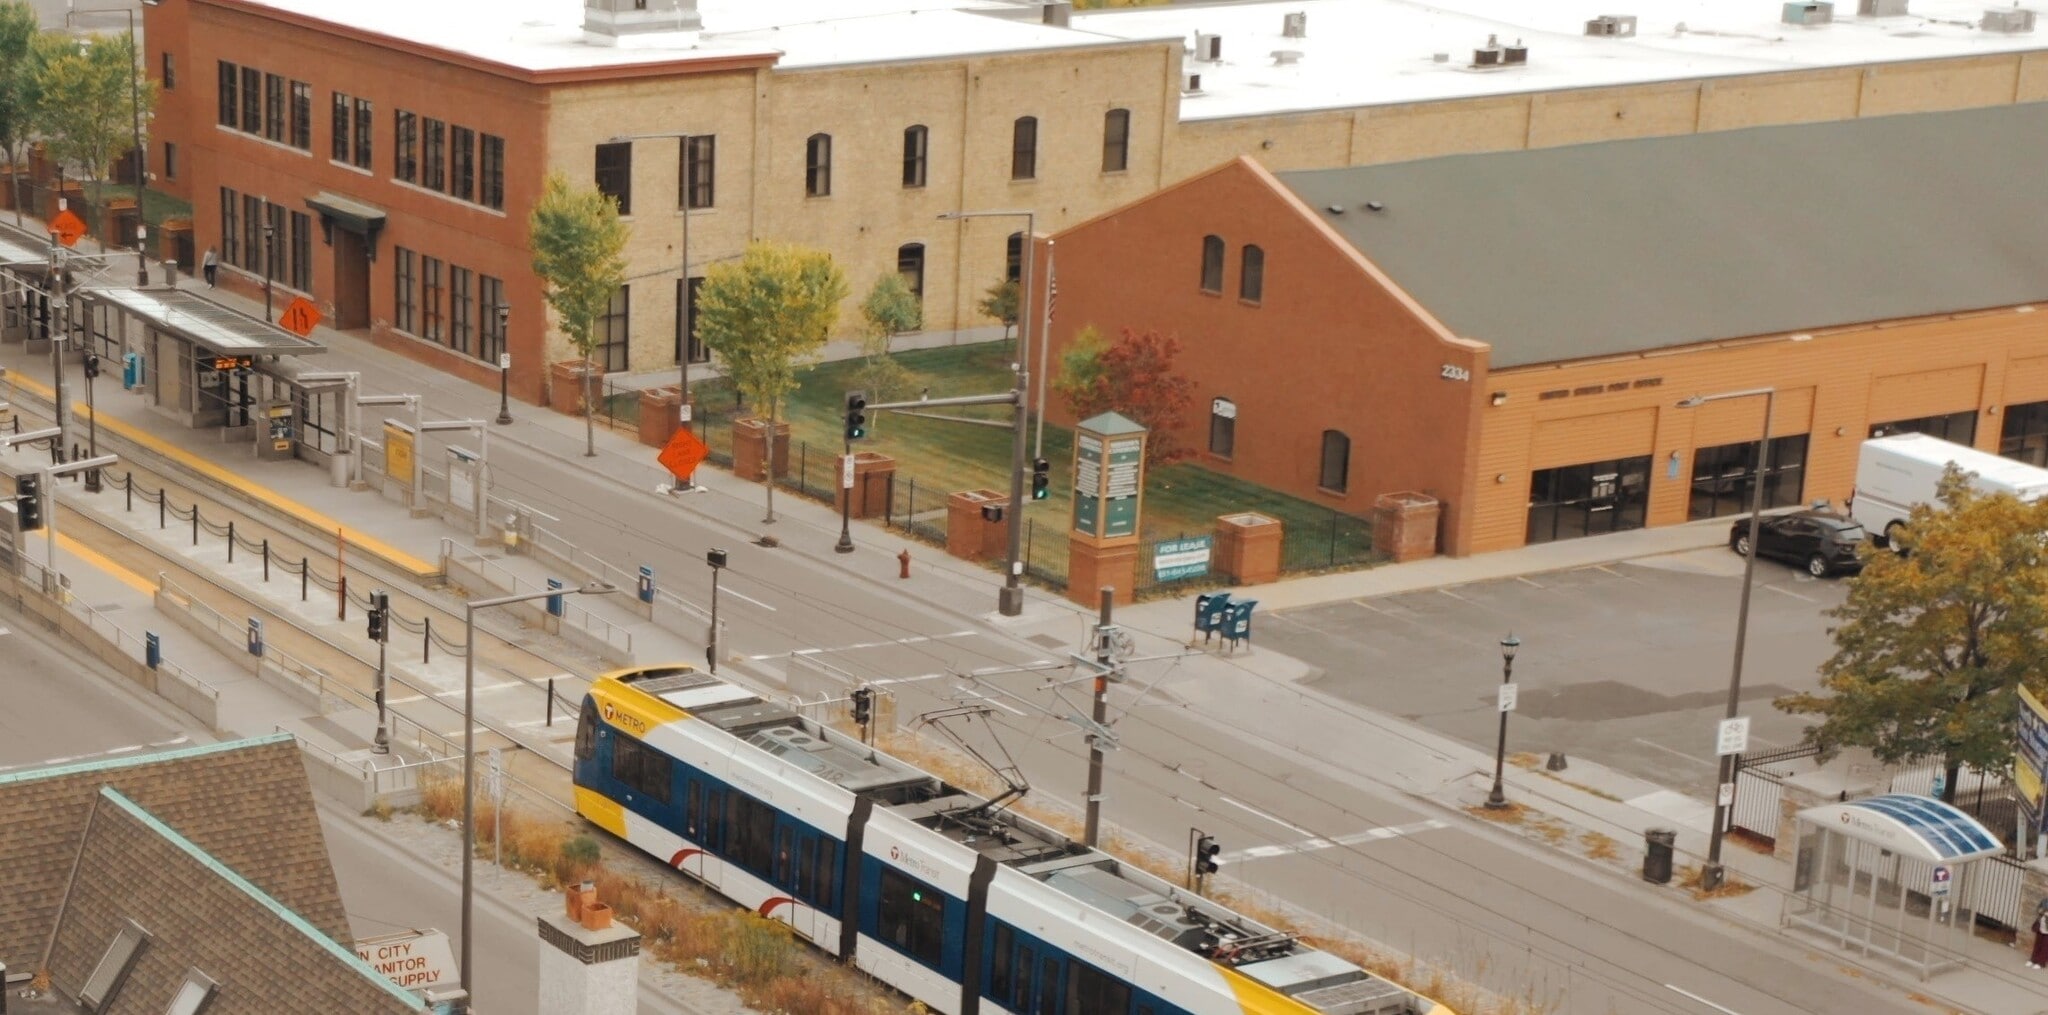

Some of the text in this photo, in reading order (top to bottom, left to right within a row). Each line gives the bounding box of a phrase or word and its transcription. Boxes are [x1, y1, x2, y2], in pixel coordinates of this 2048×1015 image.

[1441, 364, 1469, 381] 2334
[1160, 539, 1207, 554] FOR LEASE
[616, 711, 646, 733] METRO
[378, 944, 411, 960] CITY
[374, 957, 426, 974] ANITOR
[389, 969, 441, 987] SUPPLY
